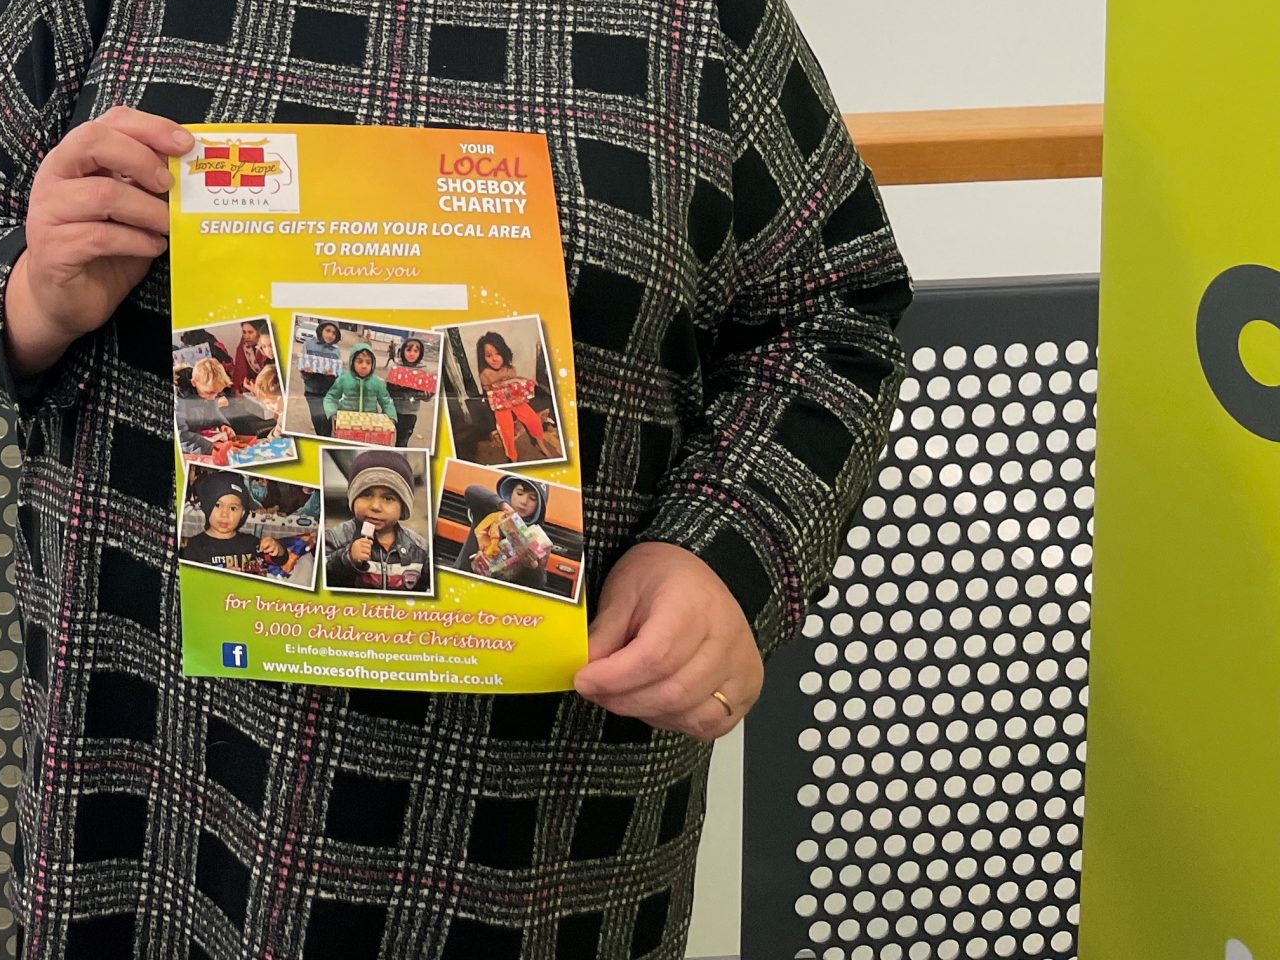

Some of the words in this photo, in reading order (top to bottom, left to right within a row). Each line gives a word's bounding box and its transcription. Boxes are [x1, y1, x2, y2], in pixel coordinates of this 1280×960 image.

[459, 143, 495, 155] YOUR
[195, 155, 226, 171] boxes
[230, 160, 246, 179] of
[250, 160, 278, 176] hope
[439, 153, 528, 179] LOCAL
[436, 177, 527, 196] SHOEBOX
[213, 198, 269, 206] CUMBRIA
[438, 195, 528, 215] CHARITY
[200, 220, 275, 235] SENDING
[278, 220, 326, 235] GIFTS
[329, 221, 378, 235] FROM
[382, 221, 428, 236] YOUR
[431, 222, 485, 238] LOCAL
[488, 224, 532, 239] AREA
[314, 242, 336, 256] TO
[340, 242, 421, 257] ROMANIA
[322, 260, 383, 277] Thank
[383, 265, 421, 282] you
[224, 593, 252, 611] for
[256, 595, 340, 620] bringing
[342, 605, 360, 617] a
[361, 602, 409, 620] little
[412, 607, 475, 627] magic
[476, 609, 498, 625] to
[500, 614, 544, 628] over
[254, 620, 303, 637] 9,000
[307, 623, 390, 644] children
[393, 629, 417, 645] at
[418, 629, 516, 652] Christmas
[285, 643, 296, 655] E:
[297, 644, 479, 665] info@boxesofhopecumbria.co.uk
[262, 660, 504, 686] www.boxesofhopecumbria.co.uk
